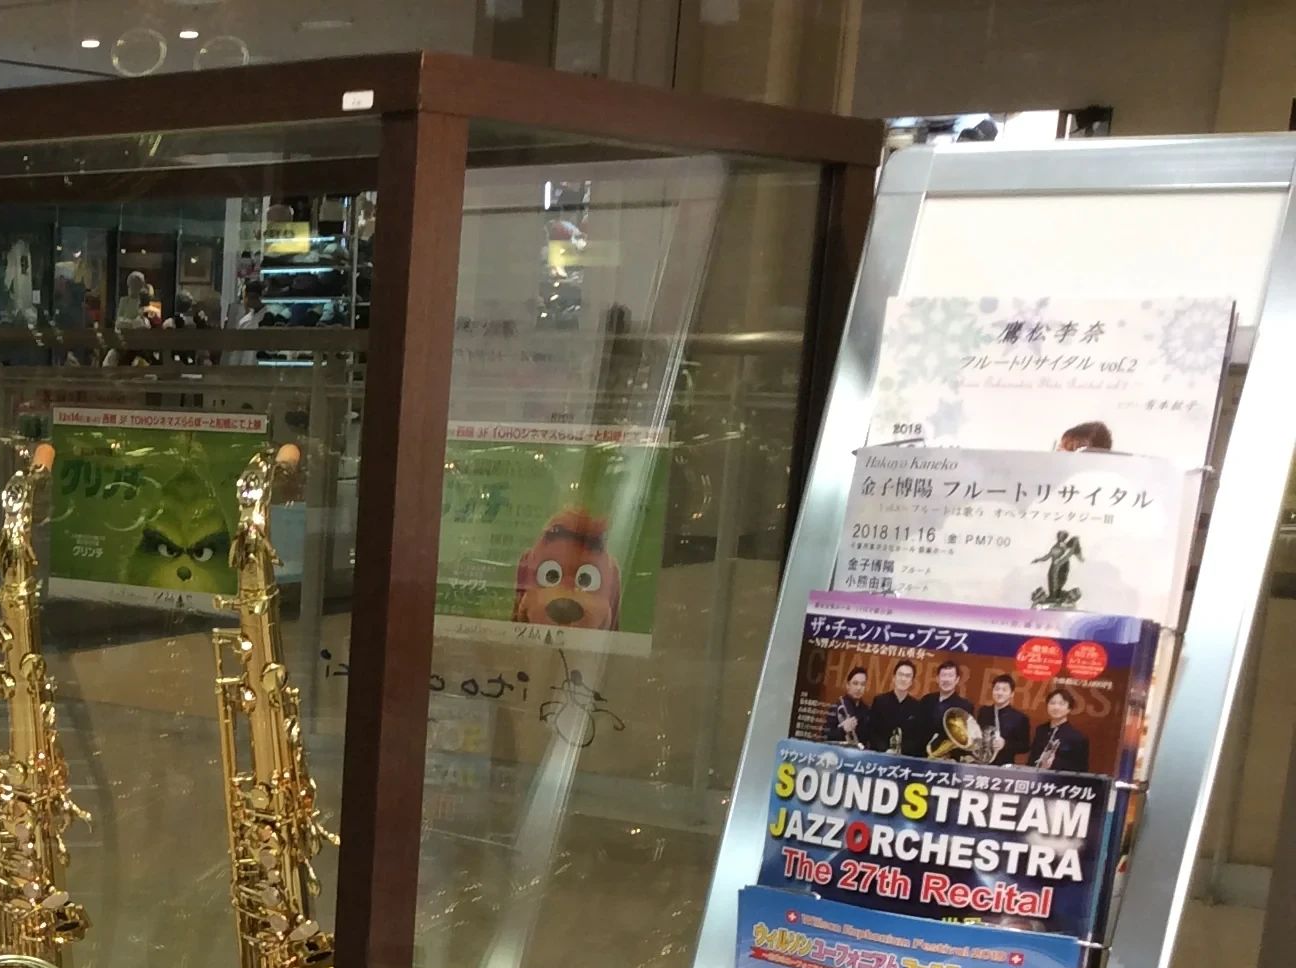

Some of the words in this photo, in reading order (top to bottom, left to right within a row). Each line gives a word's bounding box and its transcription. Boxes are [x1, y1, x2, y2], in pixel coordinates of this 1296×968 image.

[960, 355, 1095, 372] フルートリサイタル
[1099, 359, 1138, 374] vol.2
[892, 422, 923, 436] 2018
[860, 475, 934, 499] 金子博陽
[942, 480, 1155, 509] フルートリサイタル
[847, 557, 895, 575] 金子博陽
[810, 616, 970, 653] ザ・チェンバー・ブラス
[781, 847, 833, 885] The
[839, 859, 912, 899] 27th
[920, 873, 1053, 918] Recital
